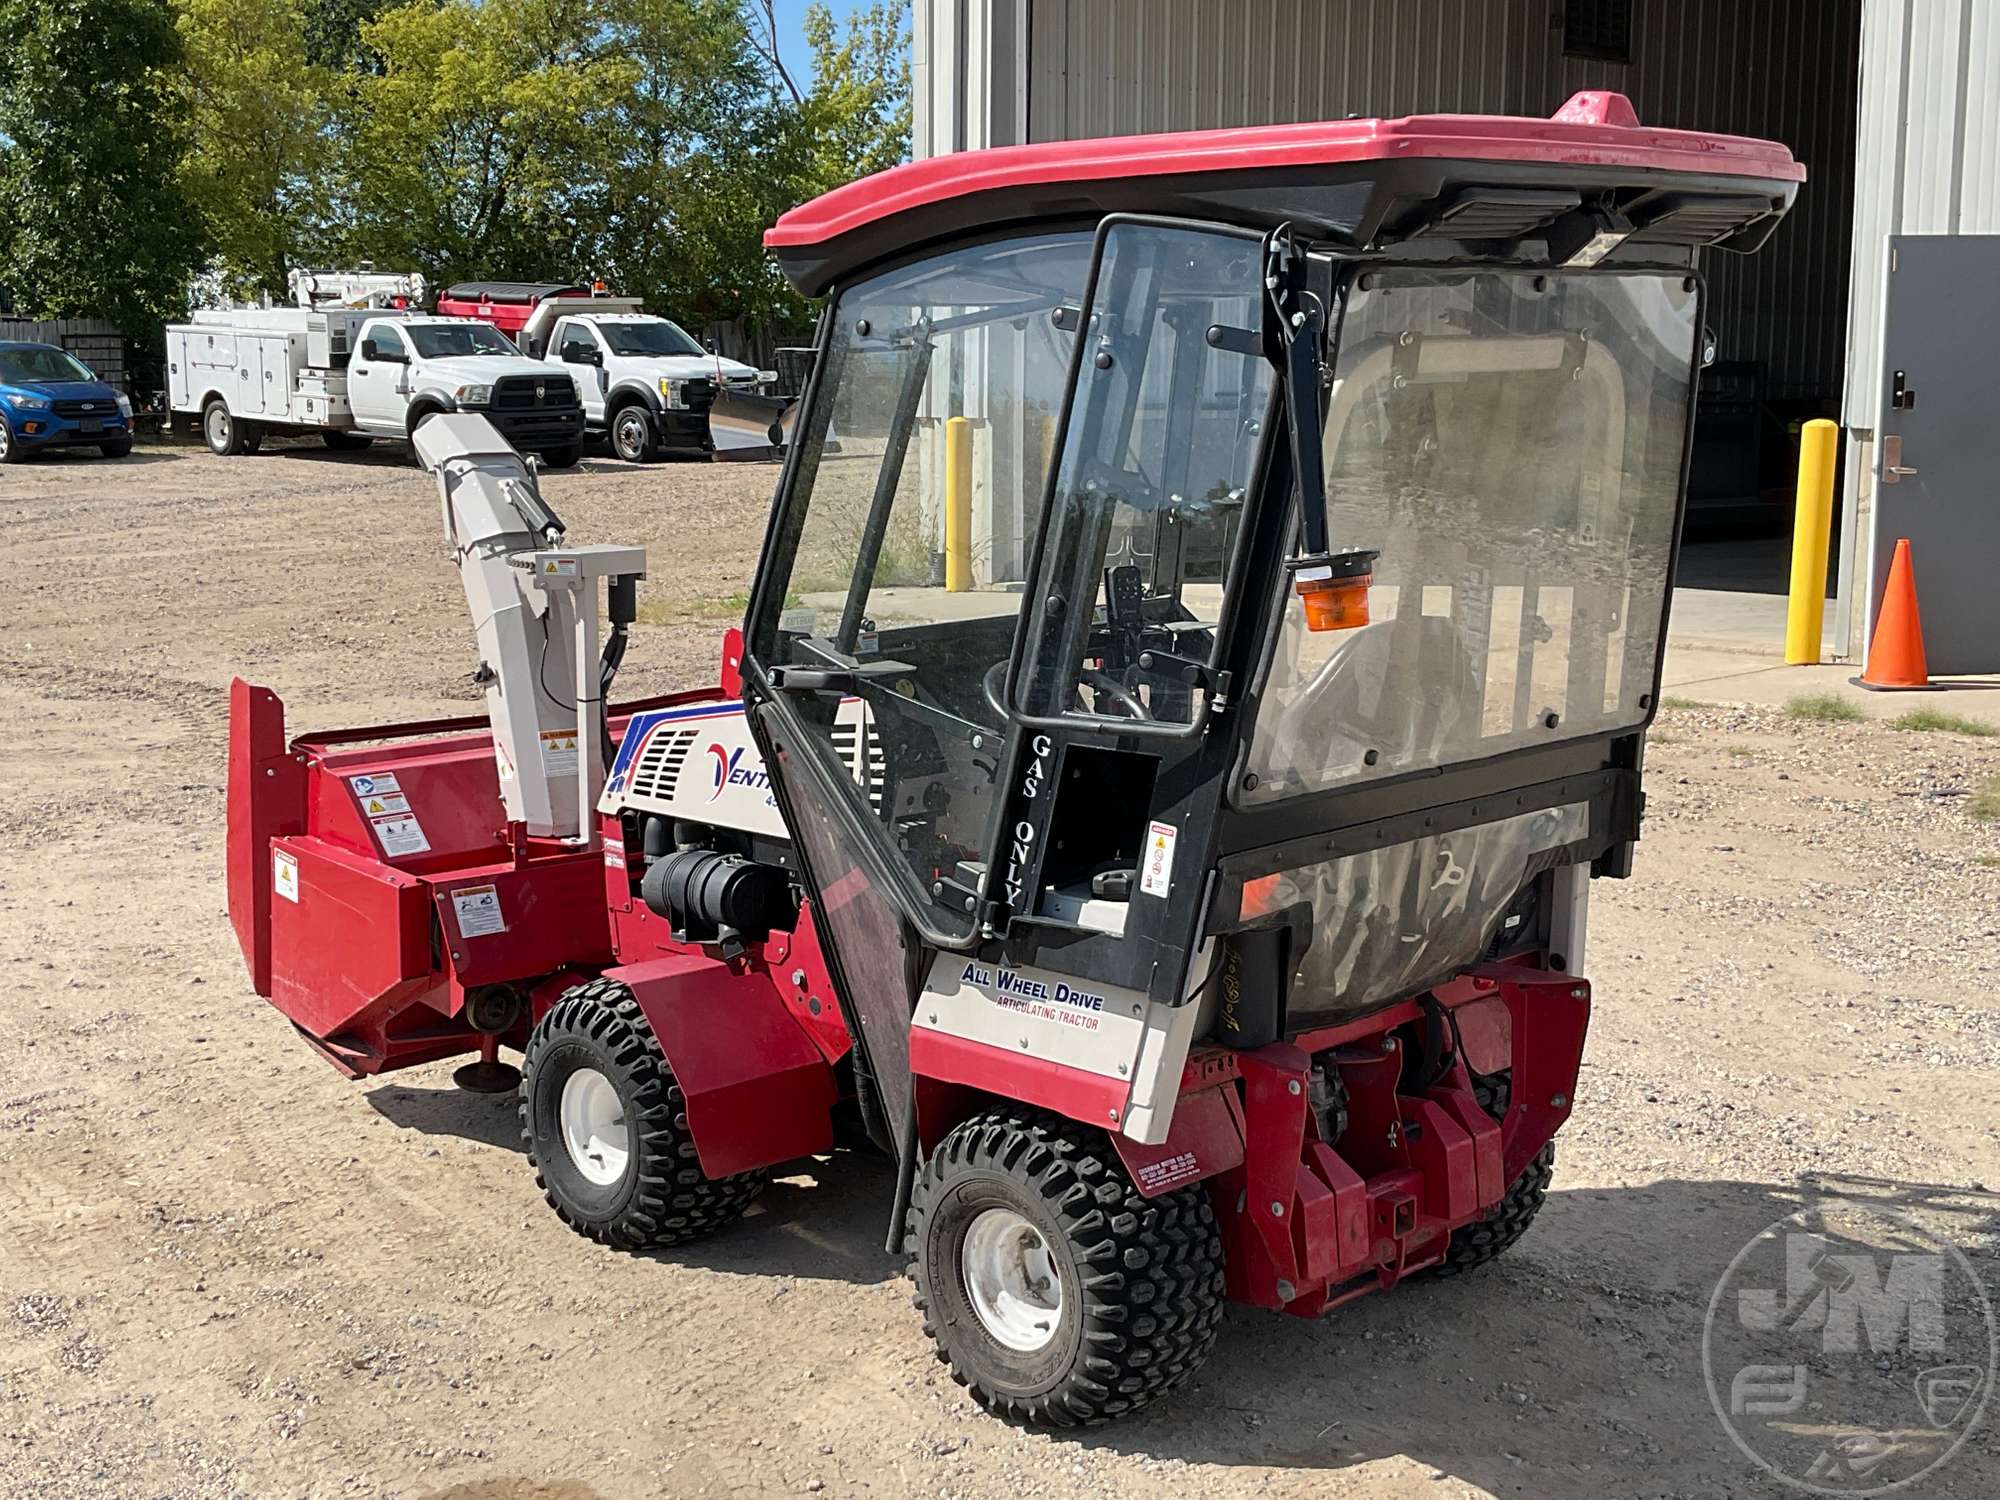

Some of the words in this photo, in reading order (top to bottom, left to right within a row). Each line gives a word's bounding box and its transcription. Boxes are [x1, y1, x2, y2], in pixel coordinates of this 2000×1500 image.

[1022, 734, 1051, 798] GAS
[1004, 821, 1035, 907] ONLY
[995, 996, 1056, 1021] ARTICULATING
[1058, 1010, 1100, 1031] TRACTOR
